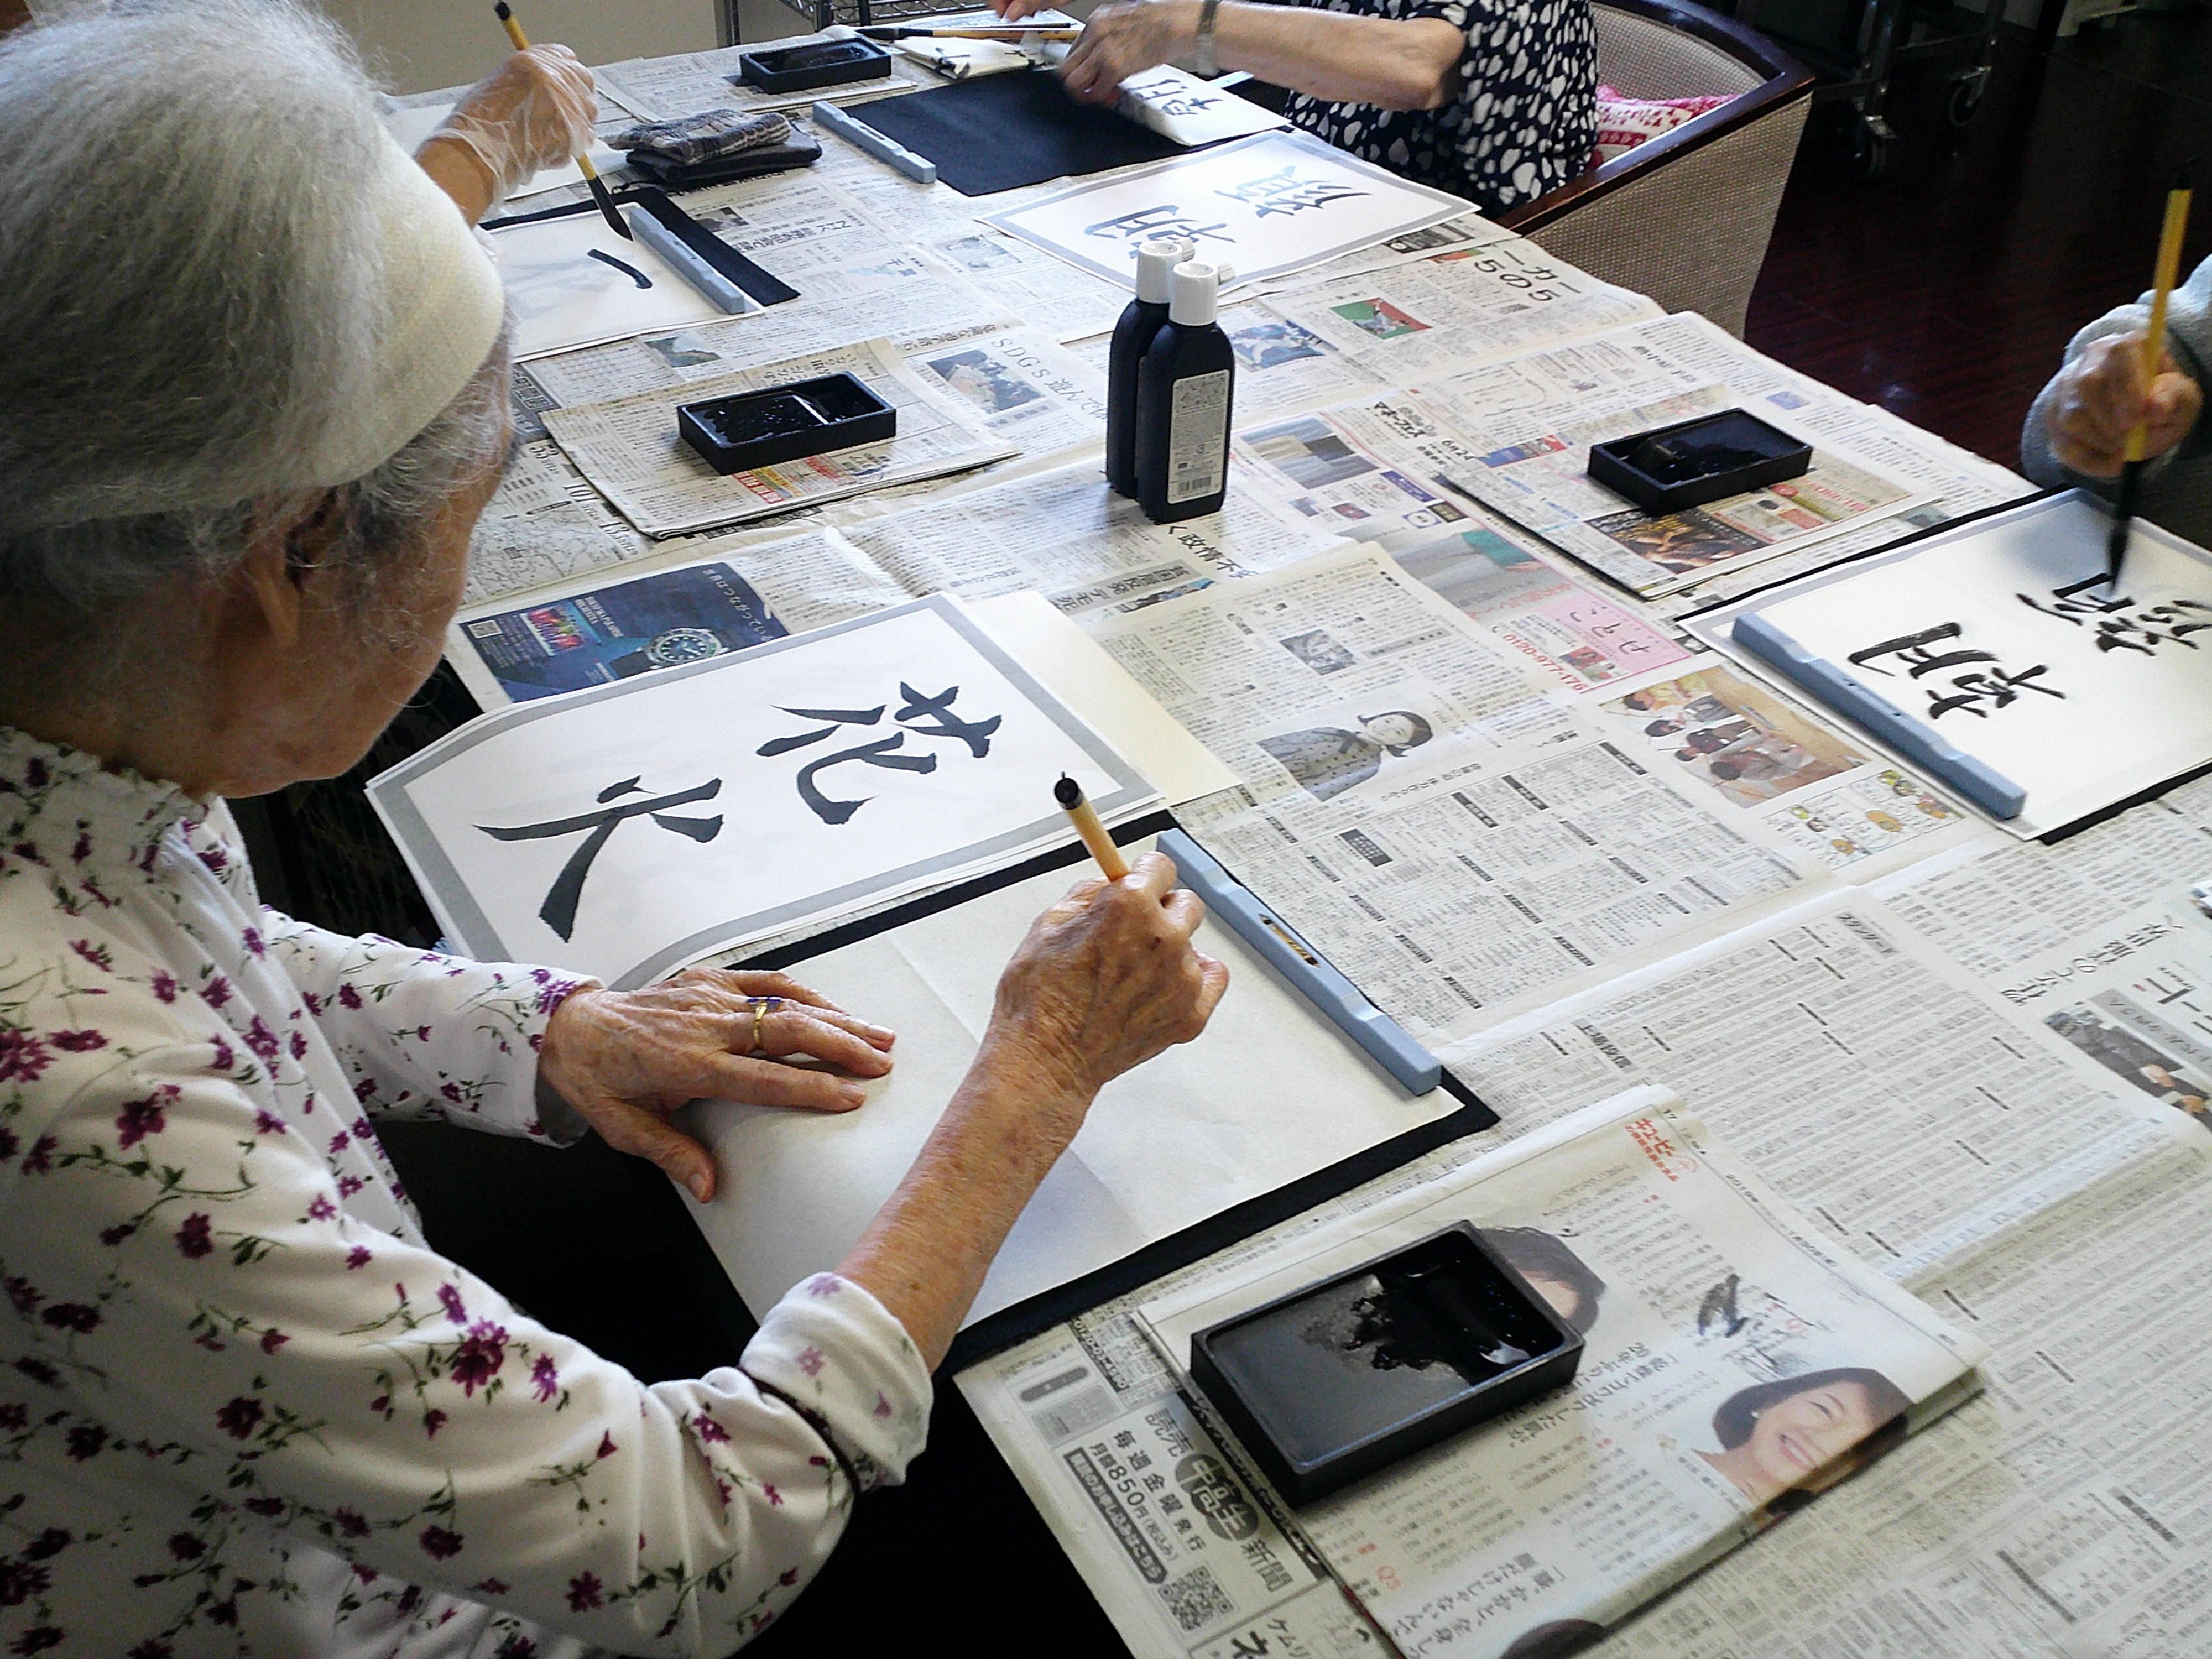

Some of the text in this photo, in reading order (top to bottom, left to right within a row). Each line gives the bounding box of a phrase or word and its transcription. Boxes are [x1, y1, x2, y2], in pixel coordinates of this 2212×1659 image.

[1502, 634, 1588, 691] 0120-977-176
[470, 680, 1003, 943] 花火
[1114, 1430, 1207, 1551] 毎週金曜発行
[1145, 1408, 1295, 1593] 読売中高生新聞
